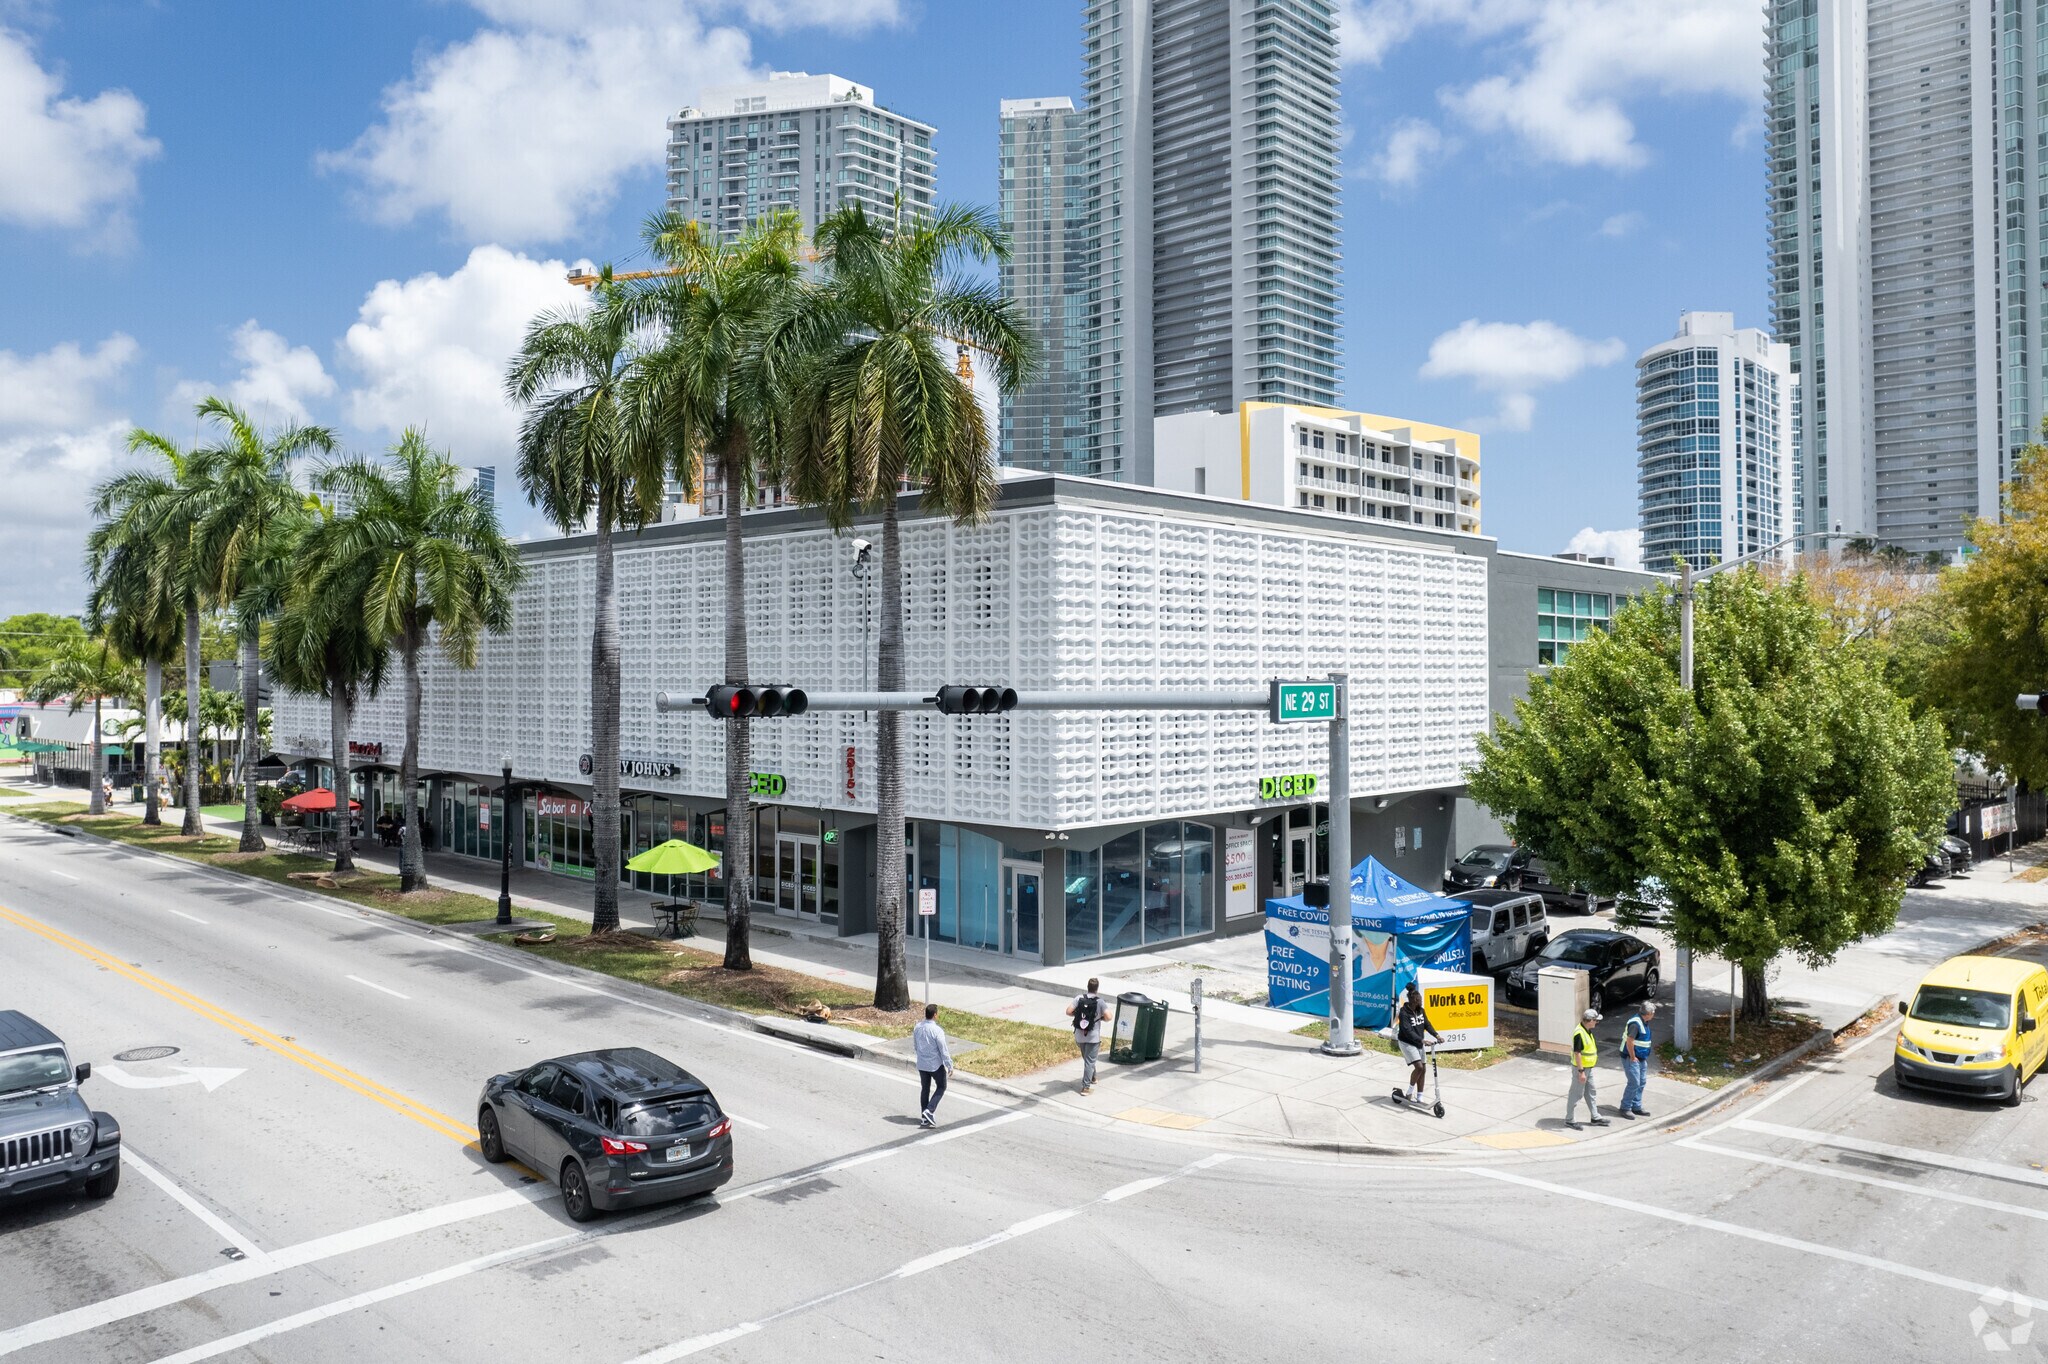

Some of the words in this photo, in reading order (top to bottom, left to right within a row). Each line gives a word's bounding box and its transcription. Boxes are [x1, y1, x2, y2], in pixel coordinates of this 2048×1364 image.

[1285, 693, 1298, 711] NE
[1301, 691, 1316, 712] 29
[1319, 692, 1330, 710] ST
[631, 760, 671, 778] JOHN'S
[748, 771, 786, 796] CED
[1261, 773, 1319, 800] DICED
[538, 798, 566, 816] Sabor
[570, 803, 577, 814] a
[1277, 906, 1298, 918] FREE
[1299, 911, 1329, 922] COVID
[1351, 917, 1382, 928] ESTING
[1271, 945, 1296, 959] FREE
[1270, 960, 1320, 977] COVID-19
[1269, 974, 1311, 991] TESTING
[1429, 993, 1457, 1007] Work
[1458, 994, 1466, 1005] &
[1467, 991, 1484, 1005] Co.
[1448, 1010, 1464, 1018] Office
[1465, 1009, 1482, 1018] Space
[1446, 1033, 1467, 1043] 2915
